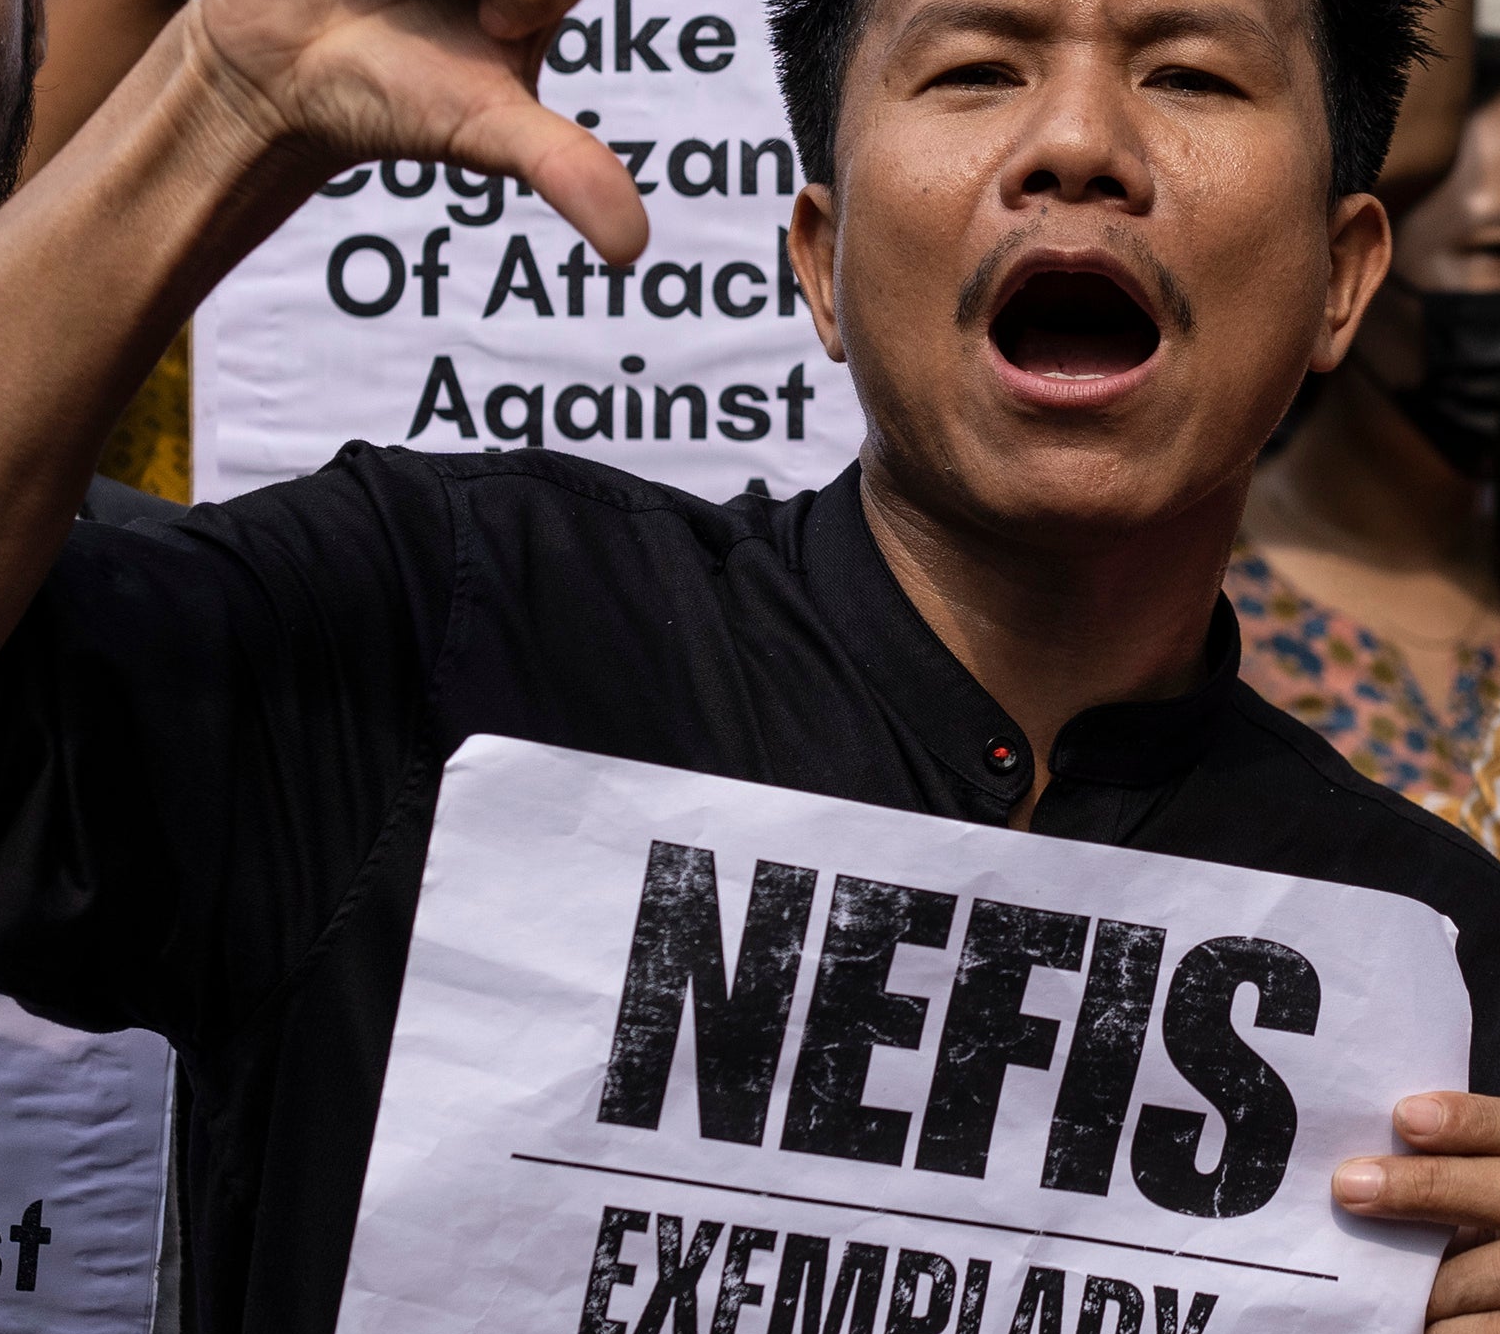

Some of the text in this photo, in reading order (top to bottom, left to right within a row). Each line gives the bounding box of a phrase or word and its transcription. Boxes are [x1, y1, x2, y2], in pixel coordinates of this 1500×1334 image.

[327, 227, 450, 317] Of
[407, 355, 813, 454] Against
[597, 839, 1322, 1219] NEFIS
